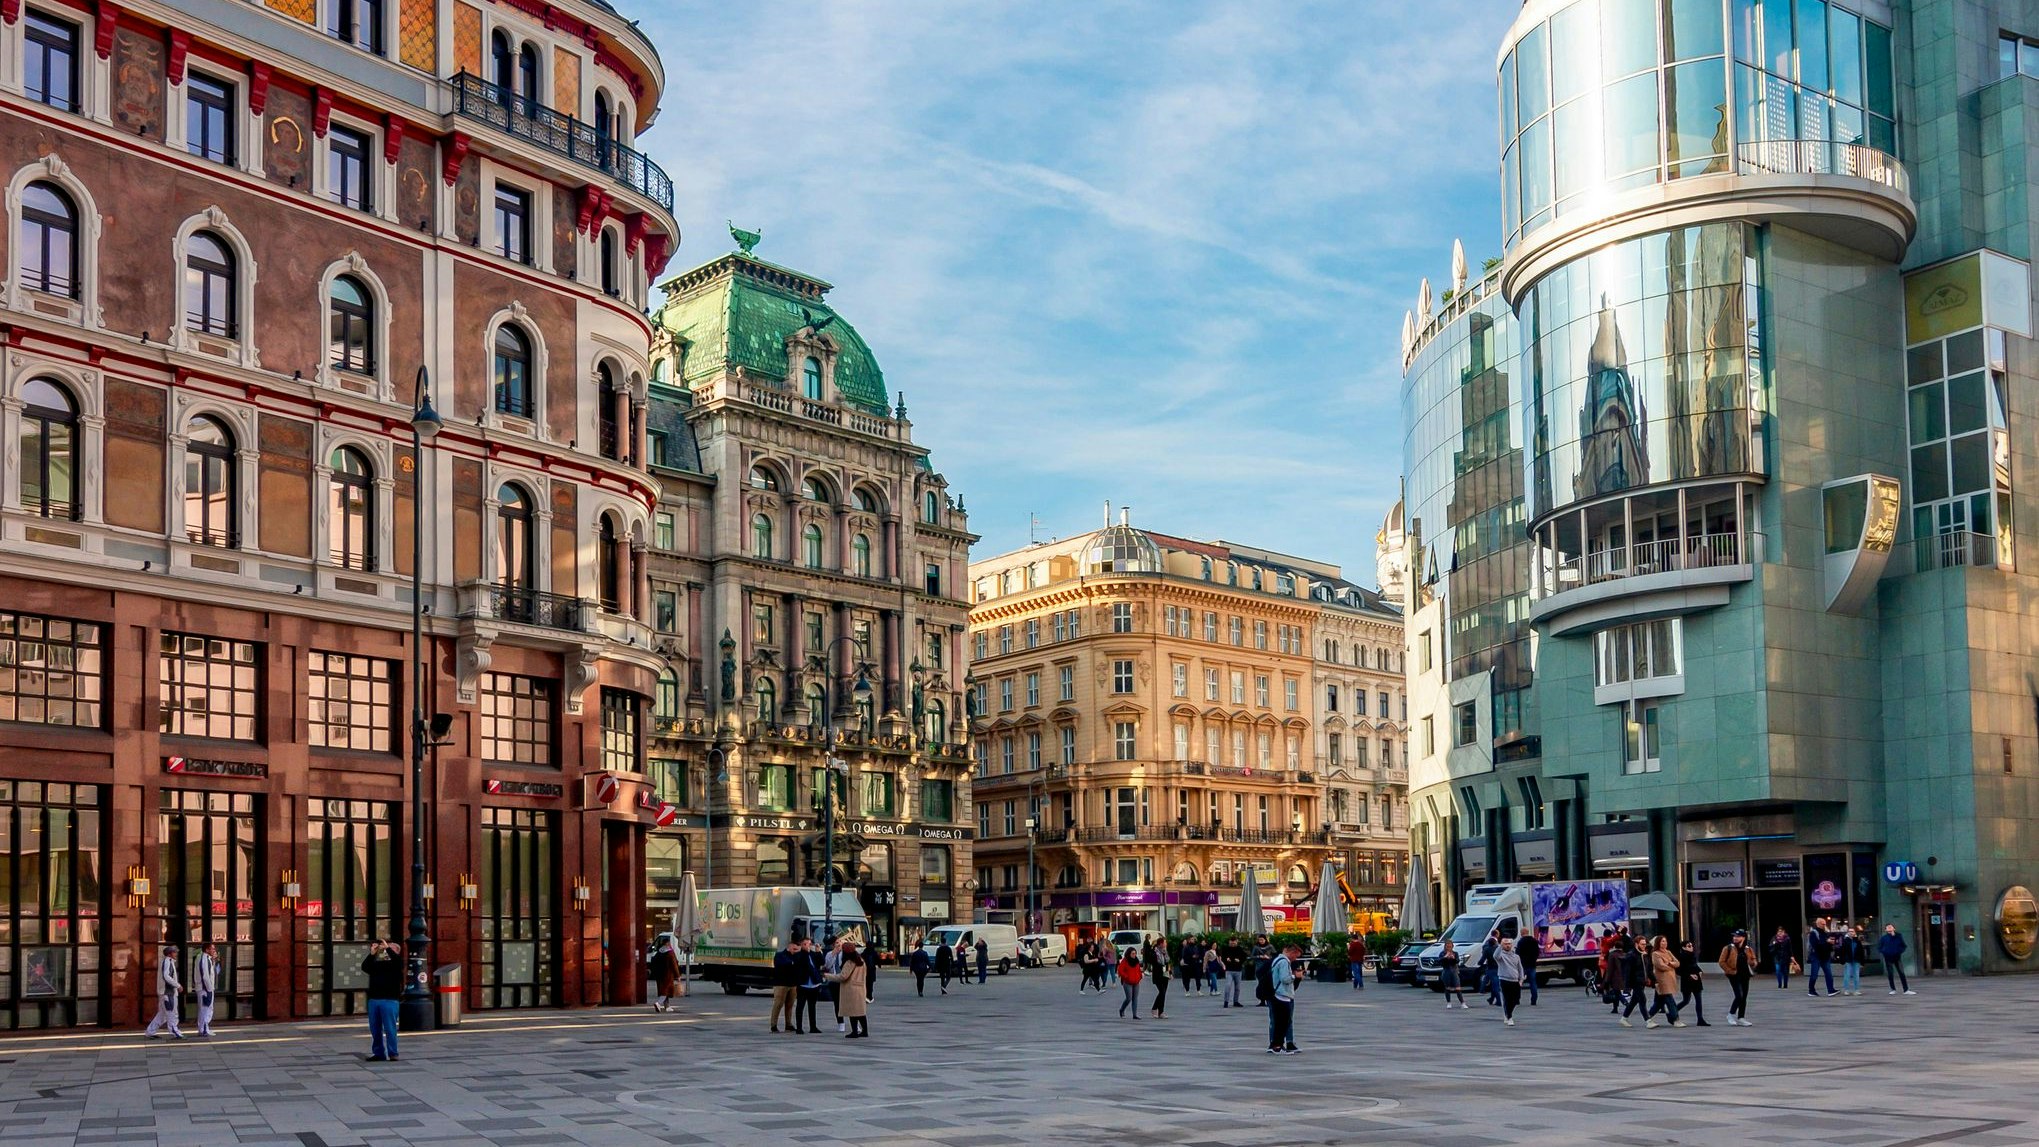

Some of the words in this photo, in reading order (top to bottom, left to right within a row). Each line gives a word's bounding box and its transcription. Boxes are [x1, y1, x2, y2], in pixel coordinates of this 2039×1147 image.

[750, 818, 794, 829] PILSTL
[863, 824, 894, 834] OMEGA
[924, 829, 952, 839] OMEGA
[1711, 870, 1736, 879] ONYX
[1886, 866, 1901, 881] U
[1906, 866, 1916, 881] U
[1262, 914, 1283, 922] ASTNER
